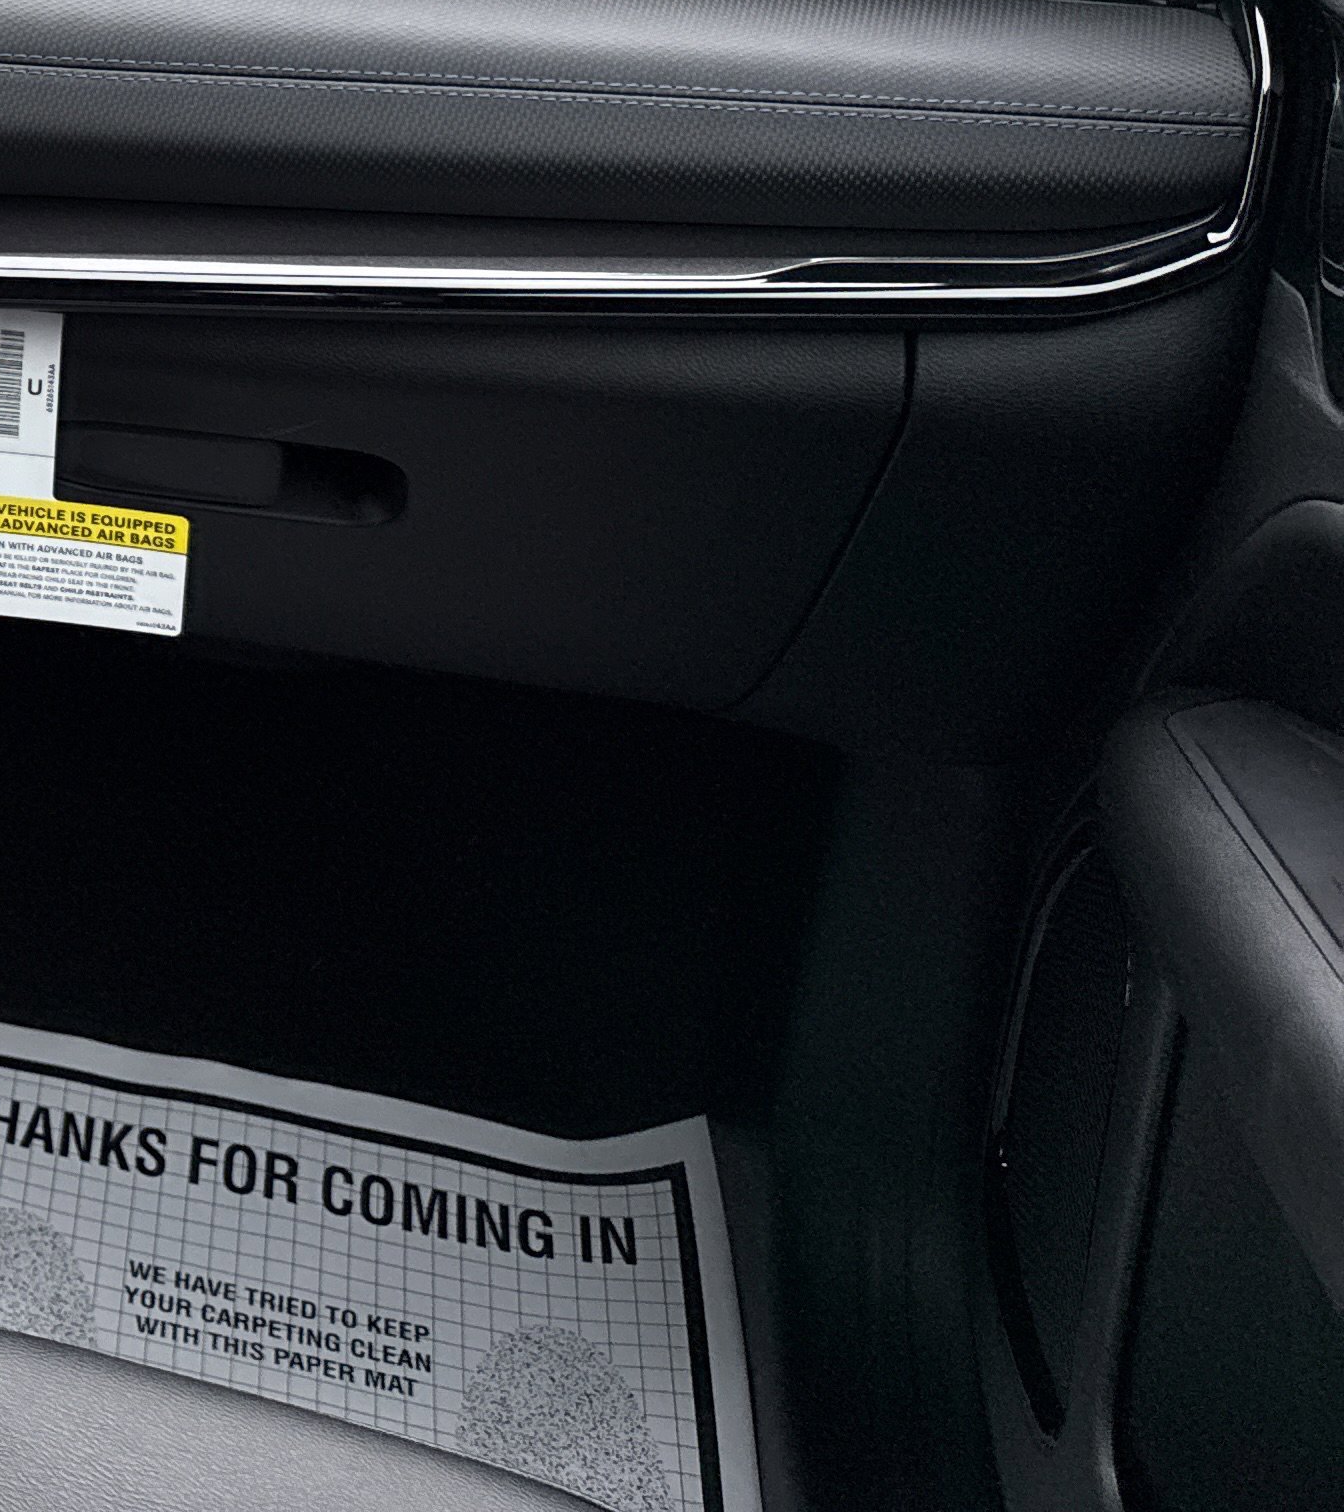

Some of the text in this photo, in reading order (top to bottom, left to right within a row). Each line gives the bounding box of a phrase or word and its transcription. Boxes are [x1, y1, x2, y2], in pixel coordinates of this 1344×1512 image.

[28, 377, 43, 396] U
[0, 518, 92, 538] ADVANCED
[97, 529, 126, 543] AIR
[130, 533, 175, 549] BAGS
[70, 510, 86, 524] IS
[91, 513, 176, 535] EQUIPPED
[8, 541, 34, 551] WITH
[37, 544, 93, 558] ADVANCED
[95, 551, 113, 560] AIR
[115, 554, 144, 565] BAGS
[14, 554, 38, 563] KILLED
[51, 558, 88, 567] SERIOUSLY
[131, 568, 144, 576] THE
[32, 565, 59, 574] SAFEST
[61, 568, 83, 577] PLACE
[44, 575, 66, 584] CHILD
[68, 578, 84, 586] SEAT
[19, 582, 42, 590] BELTS
[60, 586, 84, 595] CHILD
[64, 596, 113, 607] INFORMATION
[114, 602, 138, 611] ABOUT
[188, 1135, 299, 1205] FOR
[322, 1164, 555, 1260] COMING
[578, 1215, 638, 1266] IN
[129, 1260, 430, 1343] WE HAVE TRIED TO KEEP
[124, 1284, 432, 1373] YOUR CARPETING CLEAN
[135, 1314, 419, 1397] WITH THIS PAPER MAT
